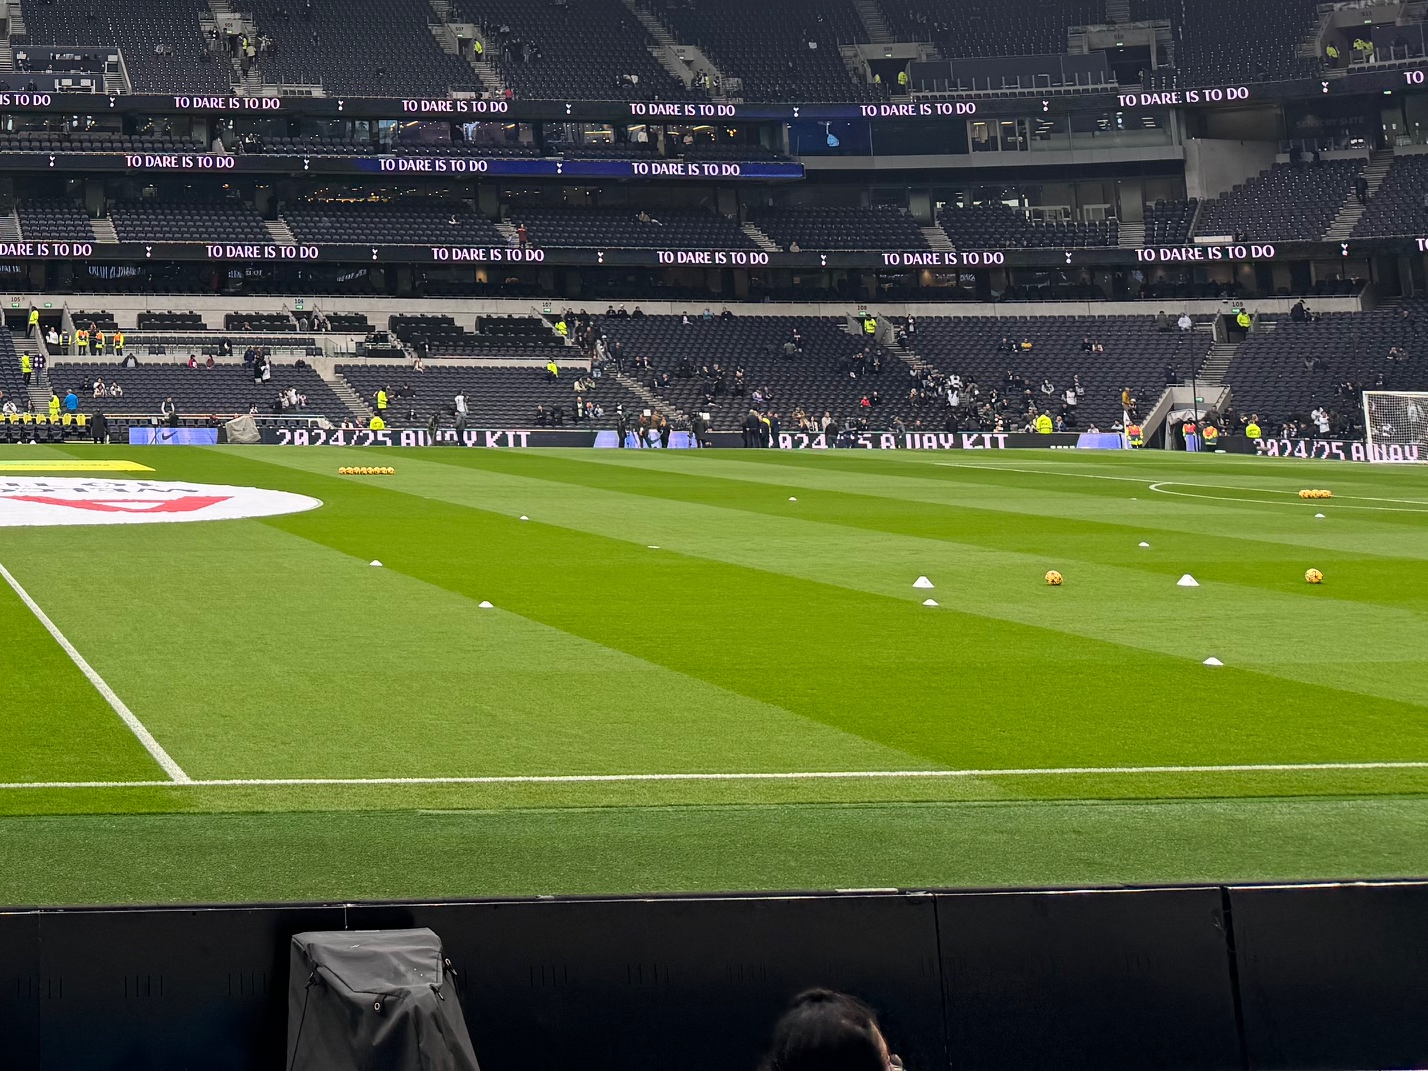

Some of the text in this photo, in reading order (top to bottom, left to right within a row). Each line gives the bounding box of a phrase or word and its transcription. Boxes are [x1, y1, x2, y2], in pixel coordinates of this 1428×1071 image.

[1403, 70, 1425, 85] TO
[0, 93, 11, 106] IS
[13, 94, 30, 106] TO
[33, 94, 51, 107] DO
[1116, 86, 1249, 107] TO DARE IS TO DO
[401, 99, 508, 113] TO DARE IS TO DO
[628, 103, 736, 117] TO DARE IS TO DO
[859, 102, 977, 117] TO DARE IS TO DO
[124, 154, 235, 169] TO DARE IS TO DO
[378, 158, 488, 172] TO DARE IS TO DO
[631, 162, 741, 176] TO DARE IS TO DO
[37, 243, 50, 256] IS
[51, 243, 70, 256] TO
[73, 243, 93, 257] DO
[431, 247, 545, 262] TO DARE IS TO DO
[656, 250, 769, 265] TO DARE IS TO DO
[1134, 244, 1275, 262] TO DARE IS TO DO
[881, 251, 1005, 266] TO DARE IS TO DO
[276, 430, 392, 446] 2024/25
[486, 431, 531, 448] KIT
[963, 433, 1008, 449] KIT
